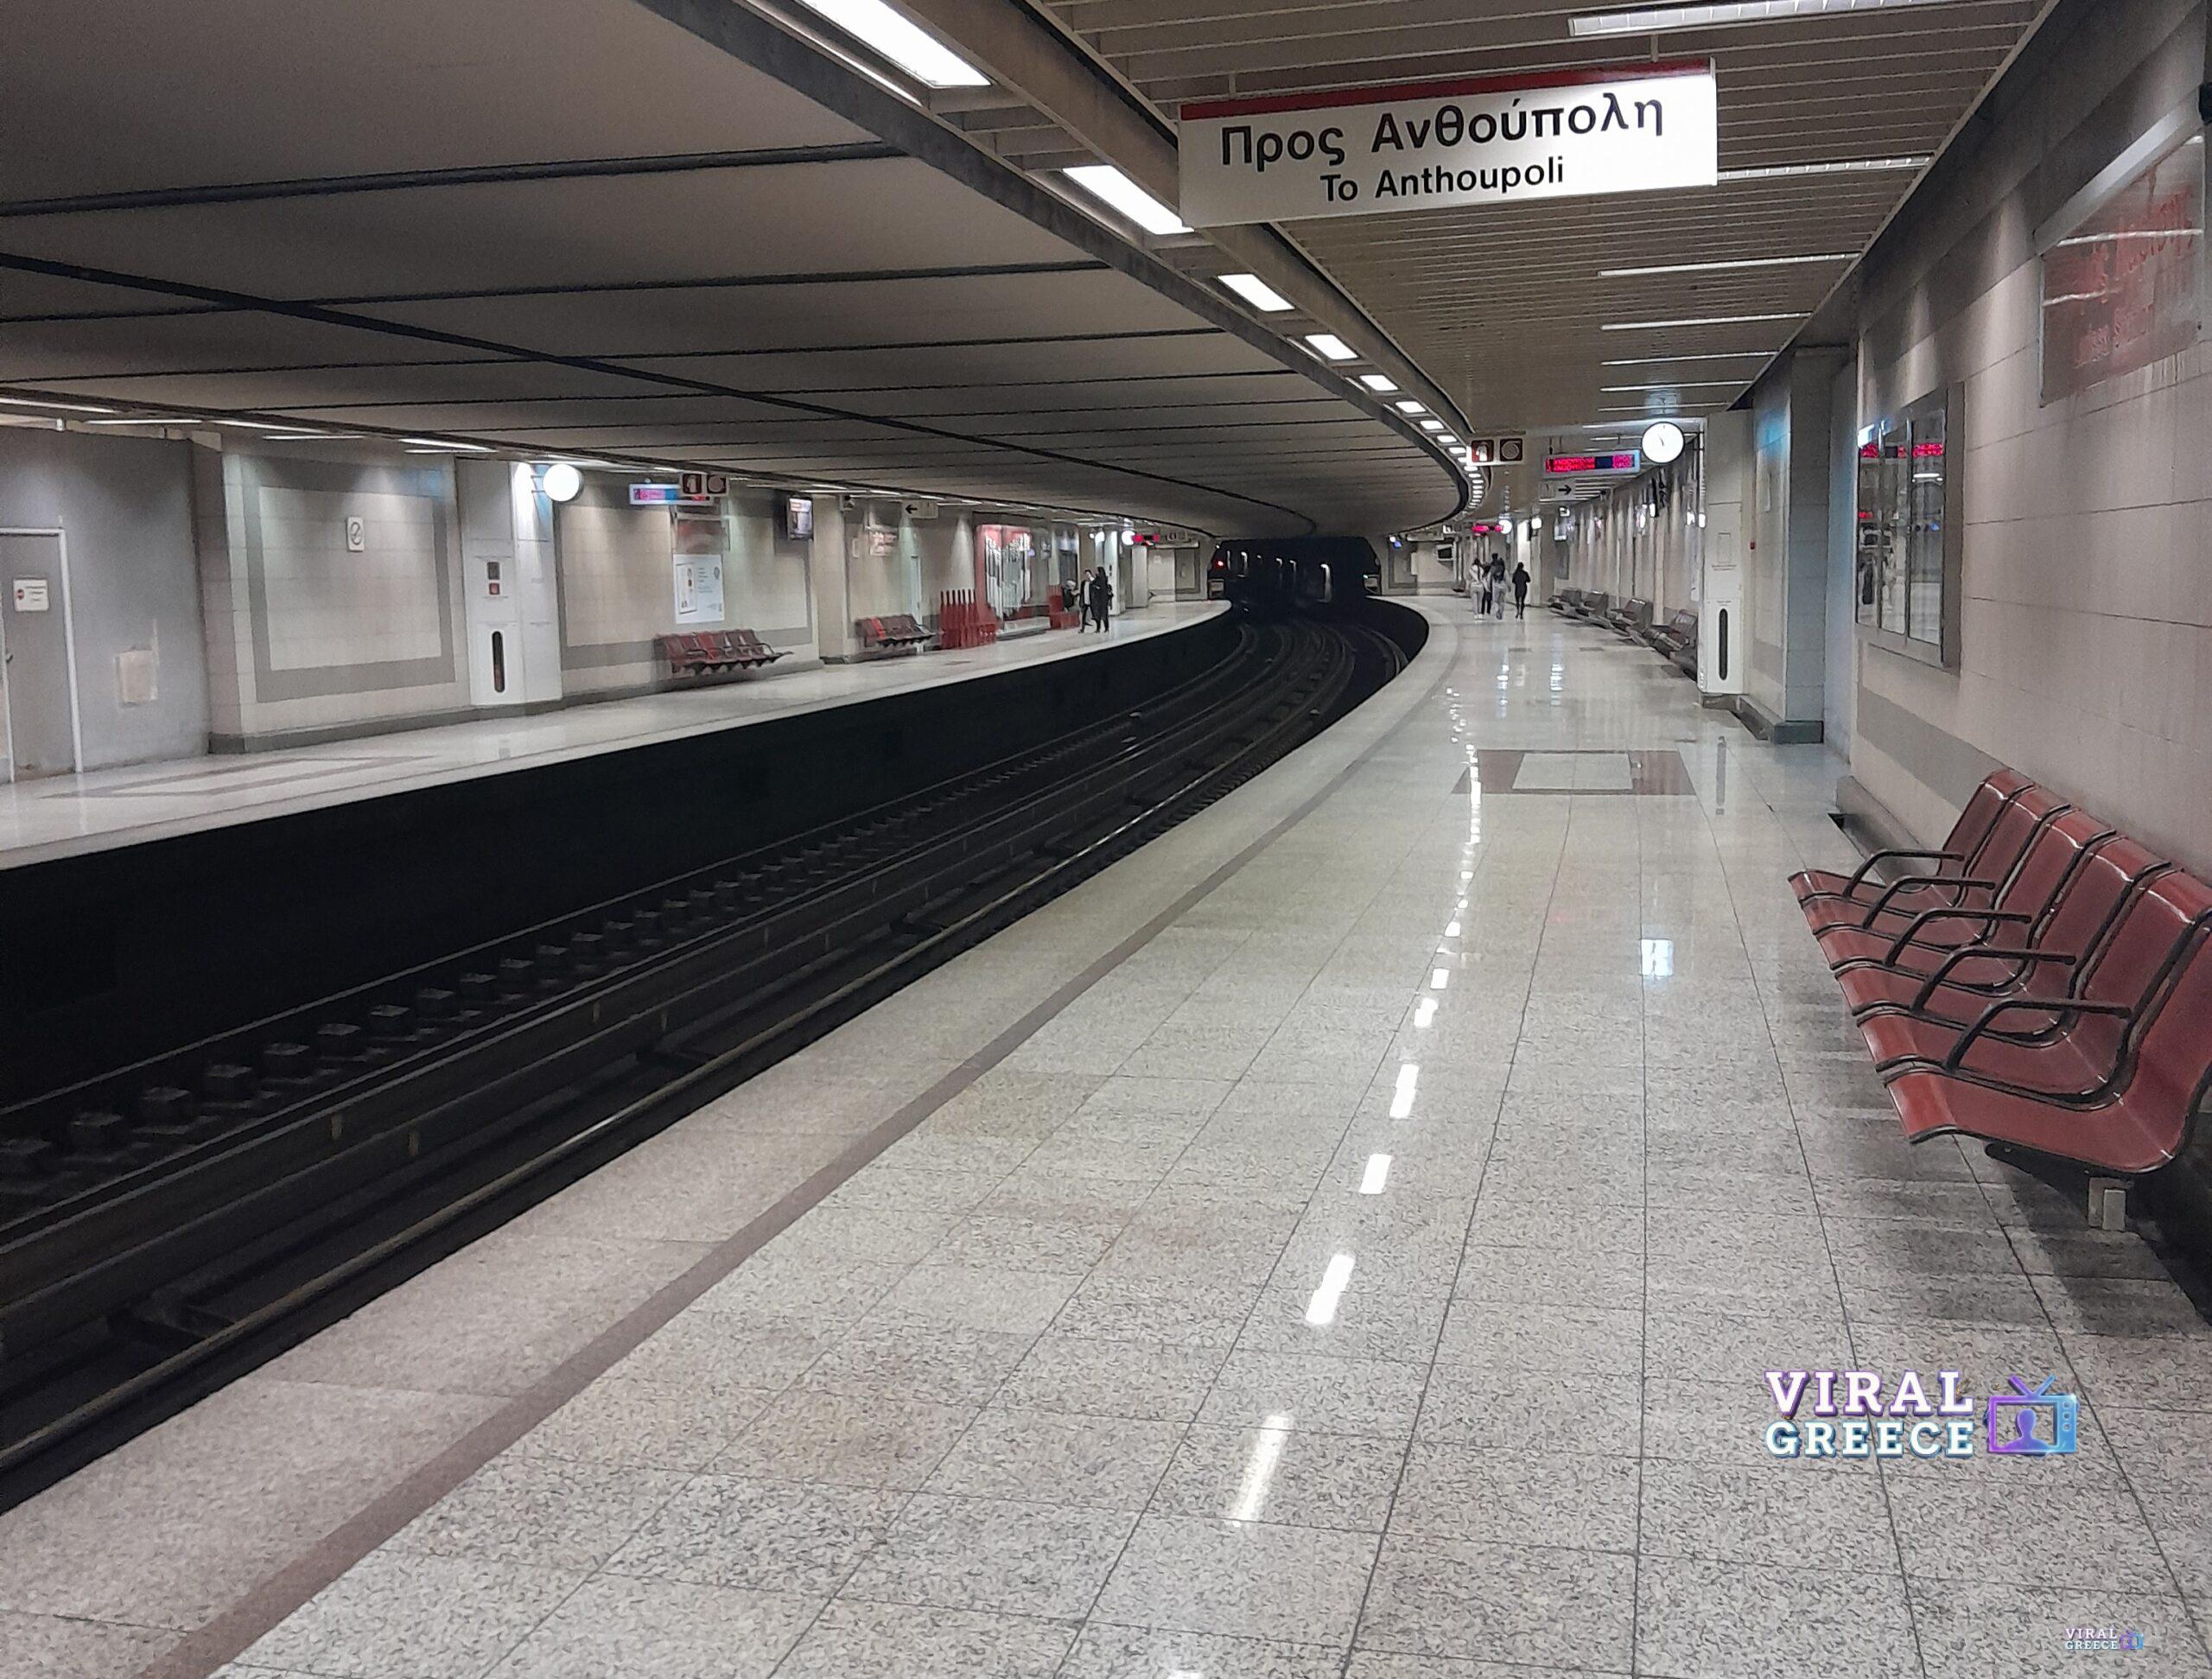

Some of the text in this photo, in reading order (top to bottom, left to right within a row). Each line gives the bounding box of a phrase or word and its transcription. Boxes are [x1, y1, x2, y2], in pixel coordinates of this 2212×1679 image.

[1222, 92, 1663, 173] Προς Ανθούπολη
[1319, 156, 1563, 202] To Anthoupoli
